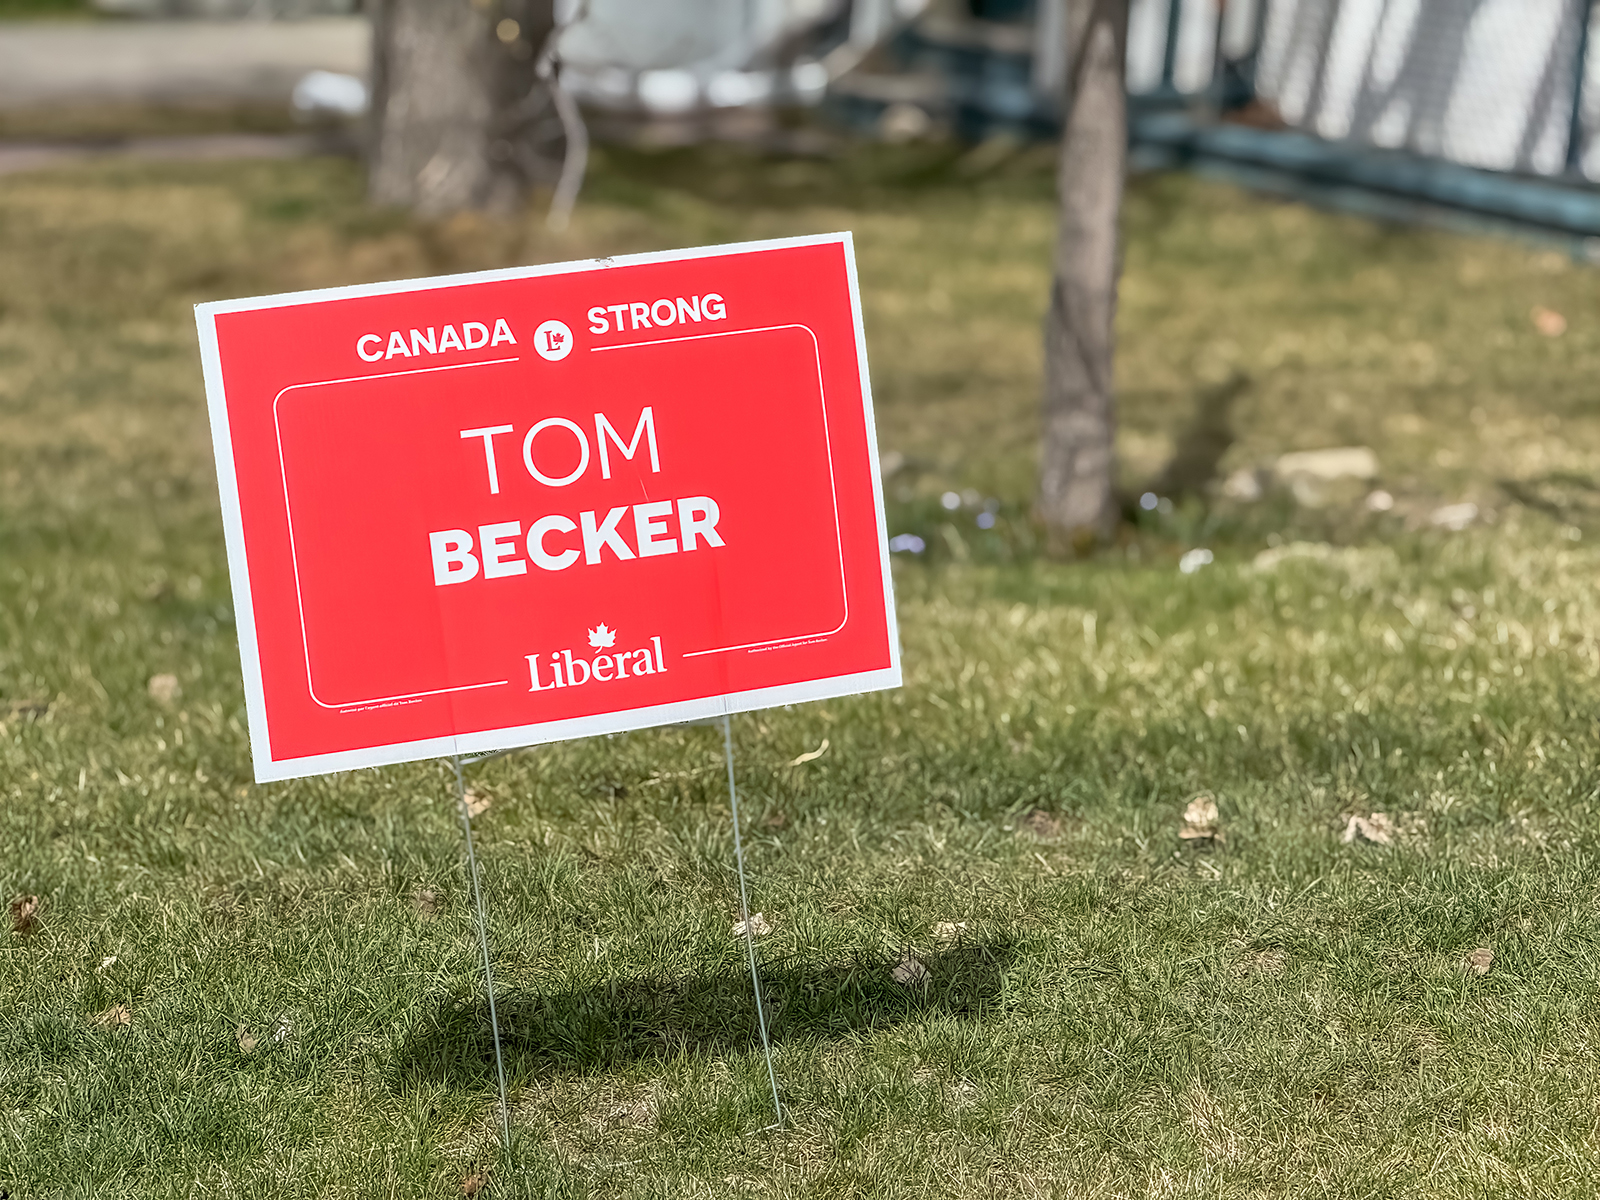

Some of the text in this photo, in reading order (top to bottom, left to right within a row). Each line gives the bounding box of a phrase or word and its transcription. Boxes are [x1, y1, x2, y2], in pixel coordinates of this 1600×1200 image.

[357, 293, 727, 363] CANADA STRONG
[460, 407, 661, 495] TOM
[429, 496, 727, 587] BECKER
